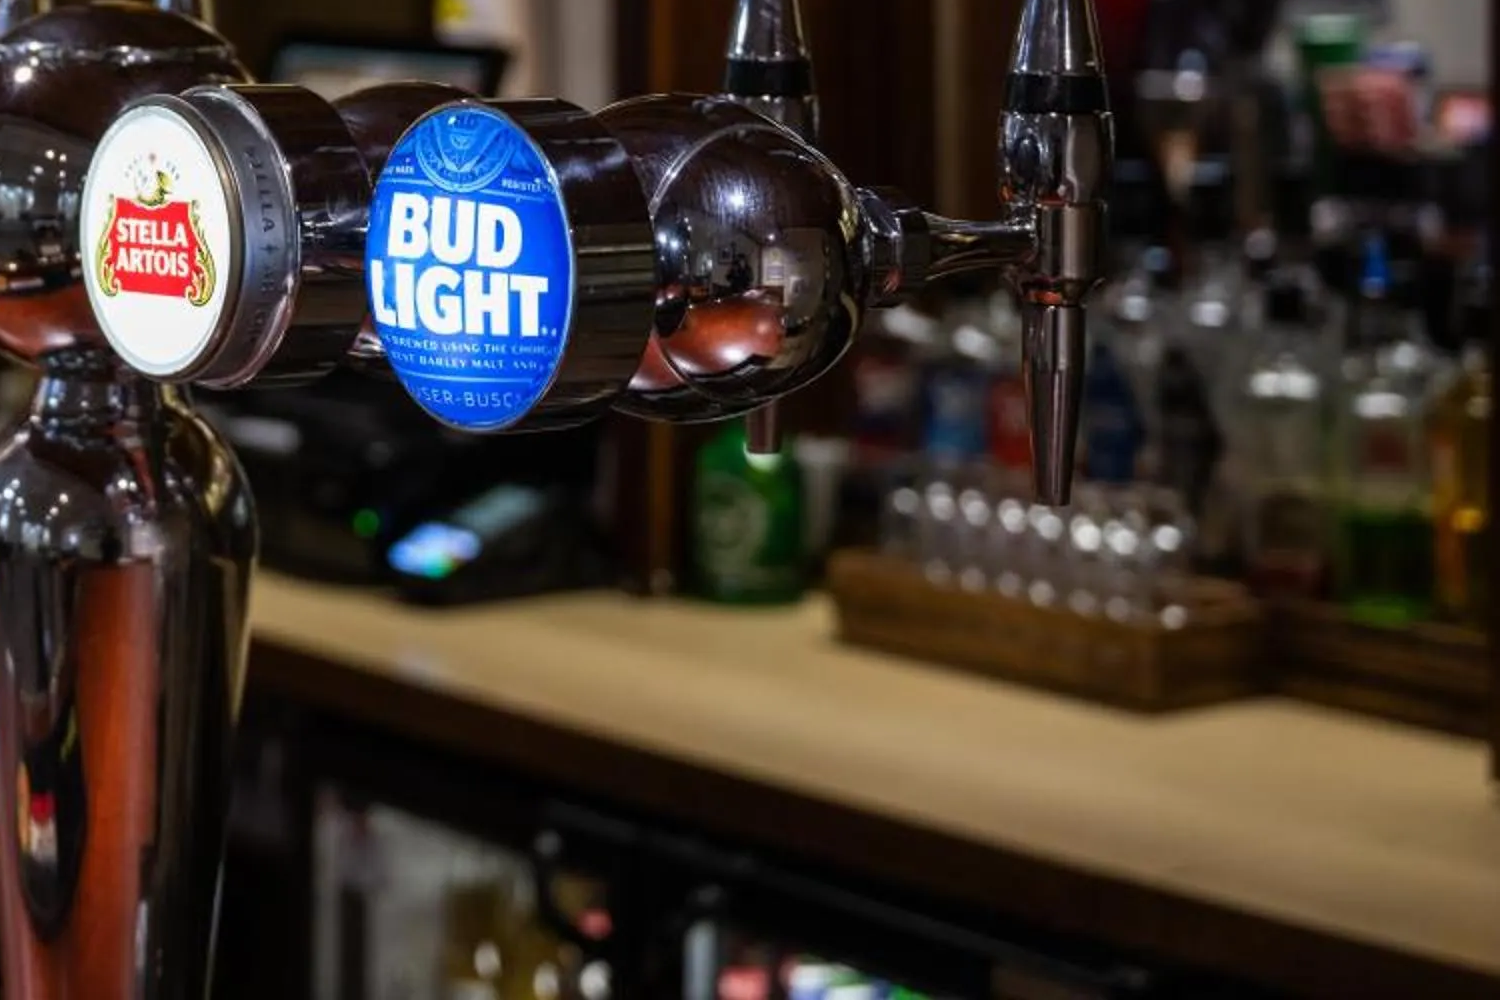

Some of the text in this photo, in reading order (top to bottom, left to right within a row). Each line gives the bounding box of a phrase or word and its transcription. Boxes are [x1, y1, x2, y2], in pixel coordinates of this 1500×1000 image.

[116, 217, 189, 248] STELLA
[387, 191, 523, 269] BUD
[115, 247, 189, 277] ARTOIS
[370, 259, 548, 337] LIGHT
[471, 359, 503, 369] MALT
